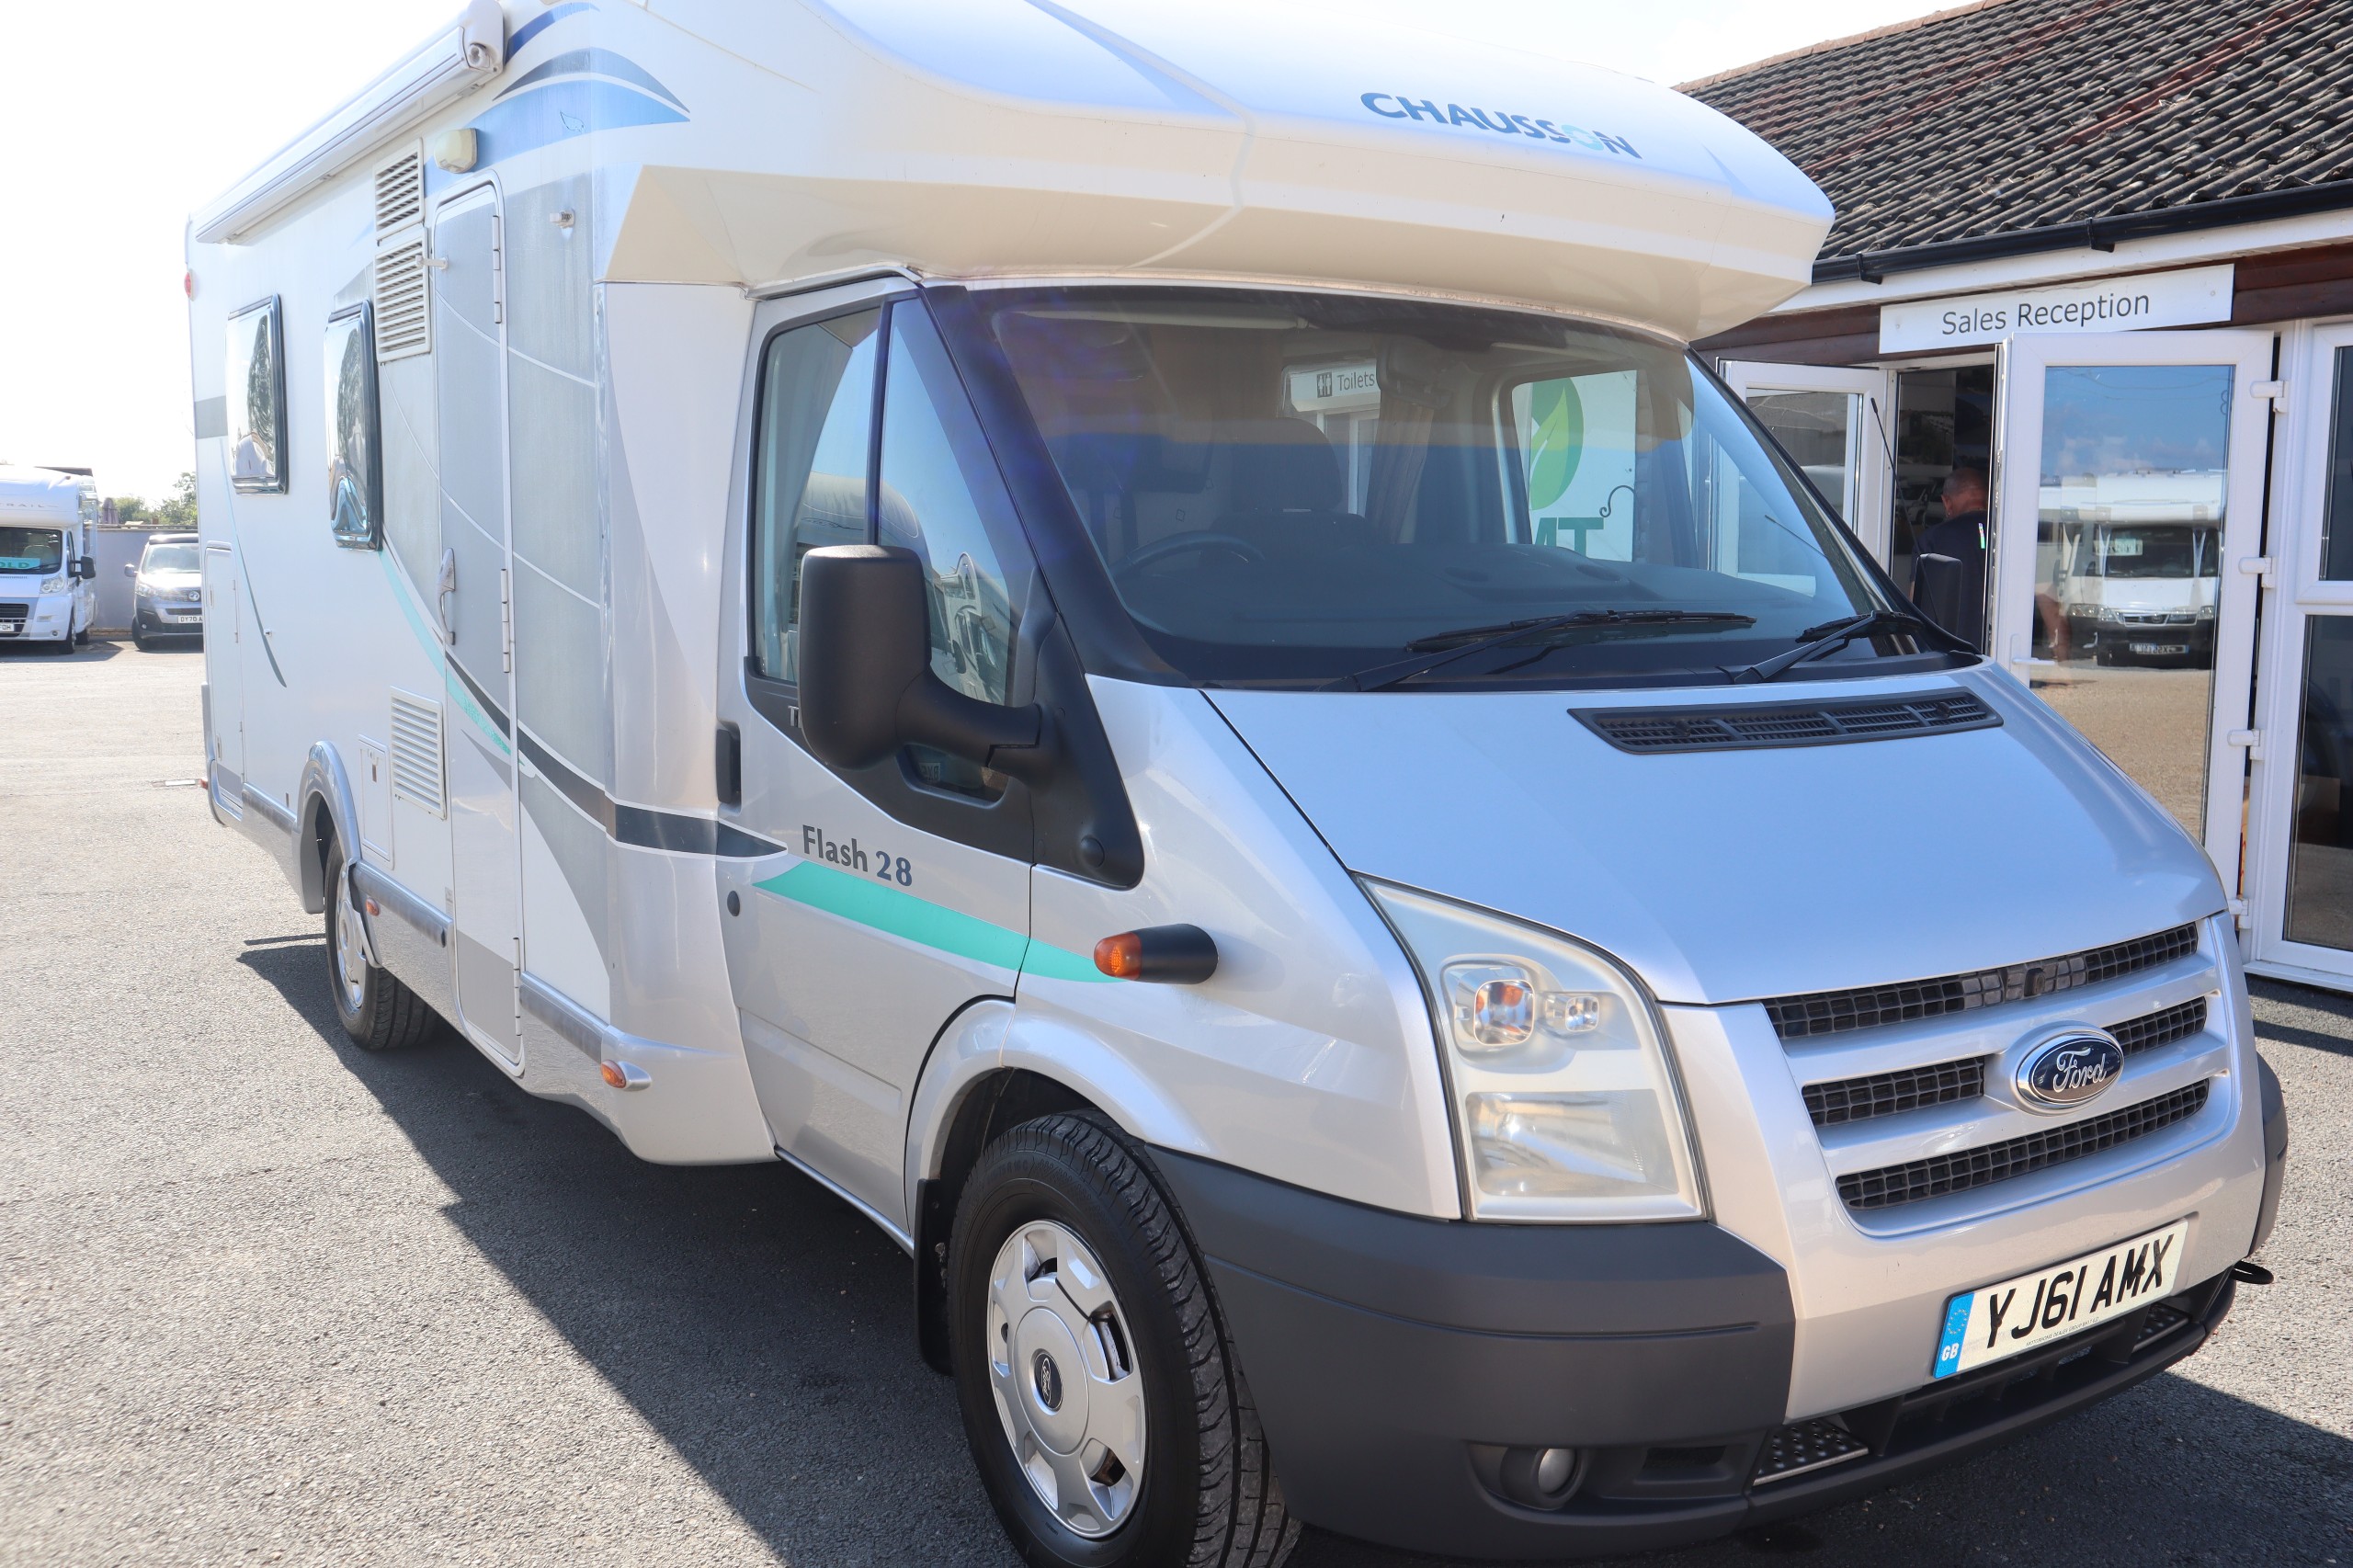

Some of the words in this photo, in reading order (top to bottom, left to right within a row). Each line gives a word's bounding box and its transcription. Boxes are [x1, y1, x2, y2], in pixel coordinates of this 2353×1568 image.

[1359, 91, 1643, 160] CHAUSSON
[1942, 307, 2006, 335] Sales
[2018, 292, 2150, 328] Reception
[1336, 370, 1375, 392] Toilets
[802, 824, 869, 873] Flash
[875, 850, 913, 887] 28
[2052, 1047, 2108, 1093] Ford
[1986, 1265, 2088, 1349] YJ61
[2089, 1233, 2176, 1314] AMX
[1940, 1343, 1959, 1362] GB
